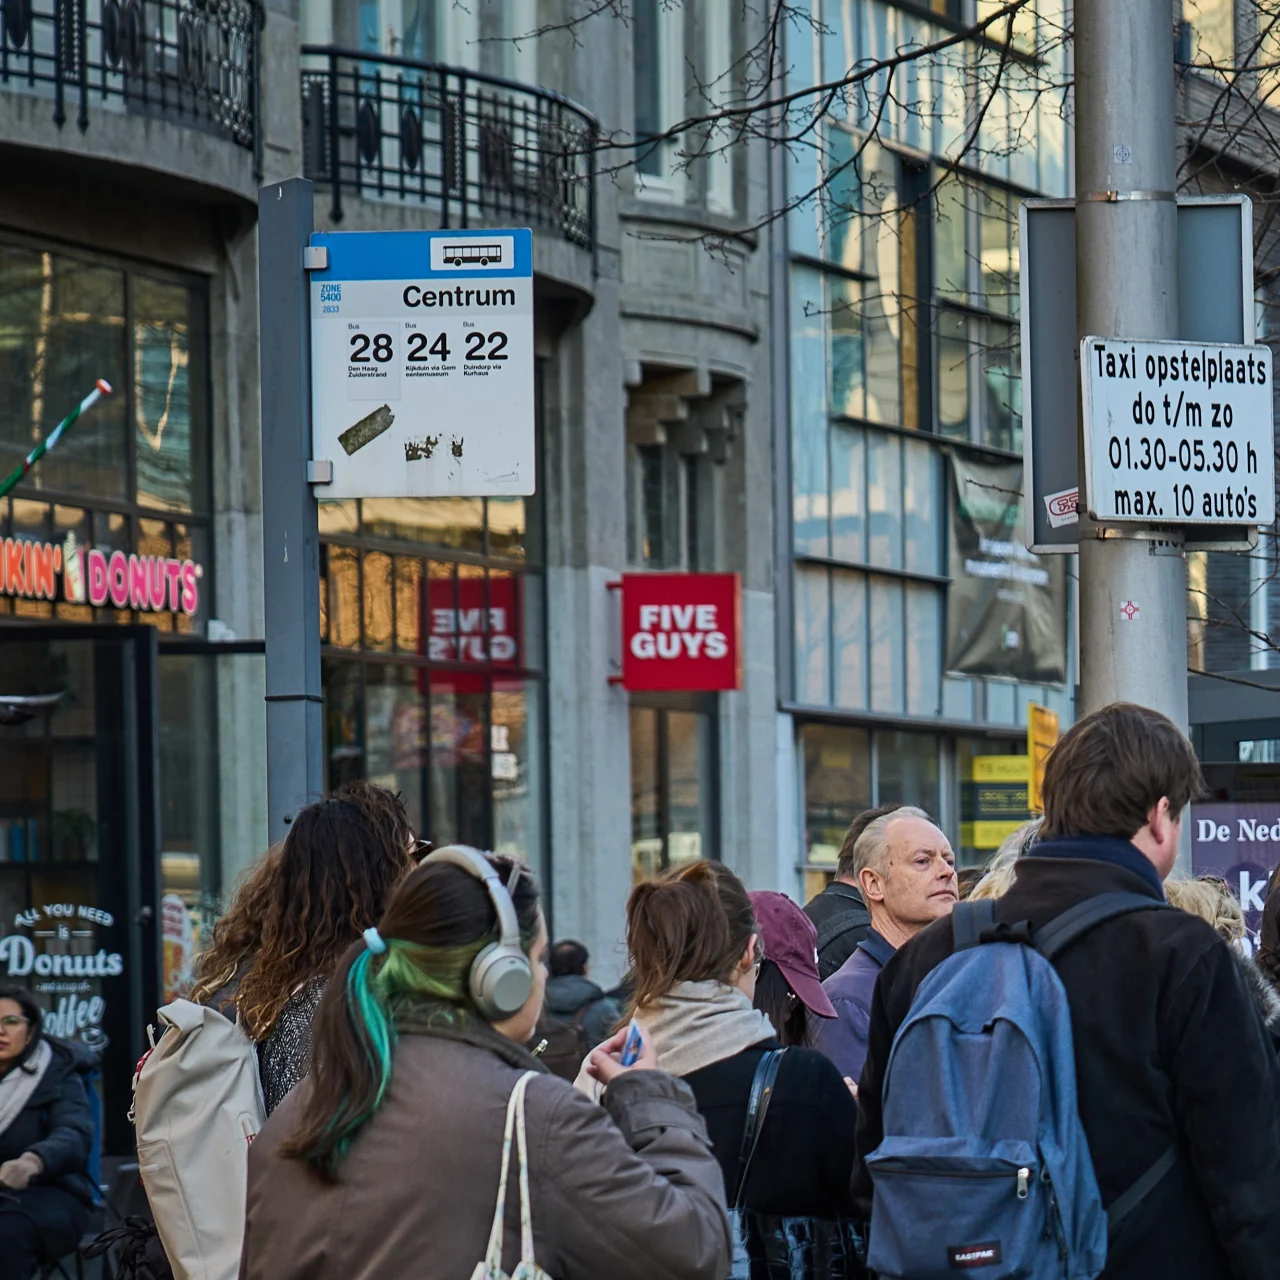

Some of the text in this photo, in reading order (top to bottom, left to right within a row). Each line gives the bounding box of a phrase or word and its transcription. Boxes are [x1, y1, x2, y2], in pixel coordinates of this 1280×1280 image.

[320, 284, 342, 293] ZONE
[320, 292, 342, 302] 5400
[403, 285, 516, 308] Centrum
[322, 305, 340, 313] 2833
[350, 331, 509, 363] 28 24 22
[362, 365, 378, 373] Haag
[405, 364, 430, 373] Kijkduin
[463, 363, 491, 372] Duindorp
[1094, 344, 1267, 390] Taxi opstelplaats
[1132, 390, 1234, 428] do t/m zo
[1108, 436, 1258, 474] 01.30-05.30 h
[1113, 489, 1164, 516] max.
[1172, 483, 1195, 517] 10
[1202, 486, 1258, 519] auto's
[0, 537, 62, 600] KIN'
[88, 549, 198, 617] DONUTS
[639, 603, 719, 631] FIVE
[629, 630, 729, 660] GUYS
[1197, 818, 1231, 842] De
[14, 903, 114, 928] ALL YOU NEED
[57, 923, 69, 941] is
[0, 934, 124, 977] Donuts
[41, 995, 105, 1039] offee
[955, 1249, 995, 1262] EASTPAK
